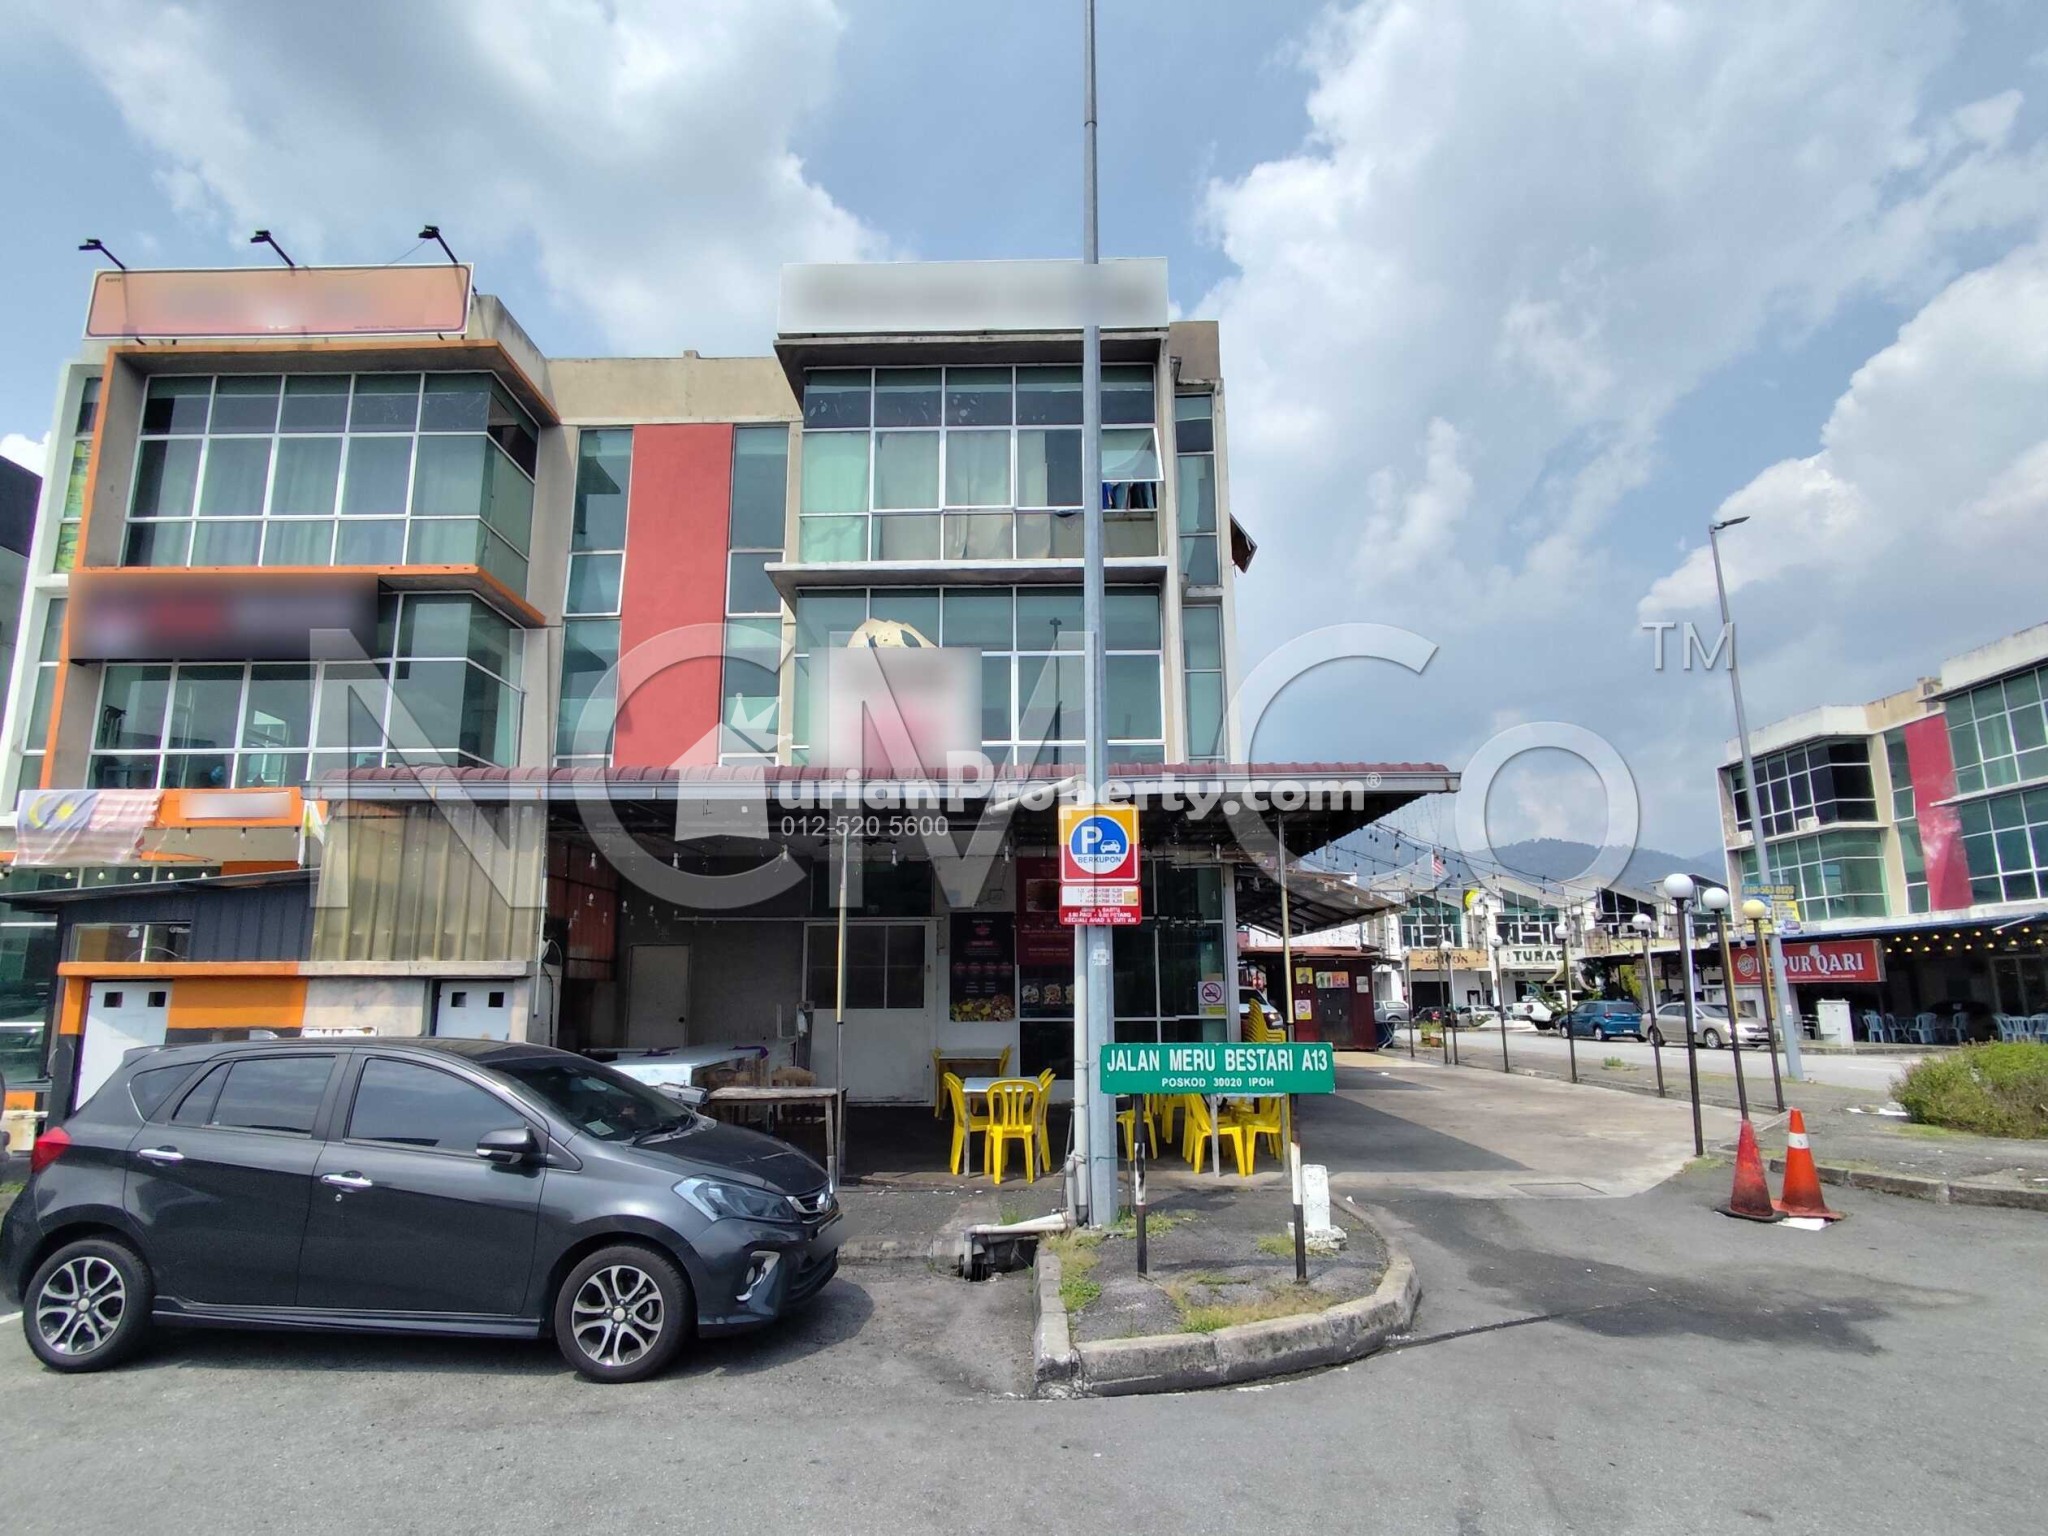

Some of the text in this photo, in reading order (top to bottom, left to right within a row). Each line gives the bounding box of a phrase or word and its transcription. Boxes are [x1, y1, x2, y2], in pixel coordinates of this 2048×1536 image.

[1081, 826, 1103, 854] P
[1816, 952, 1864, 975] QARI
[1107, 1048, 1328, 1072] JALAN MERU BESTARI A13
[1161, 1077, 1274, 1088] POSKOD 30020 IPOH
